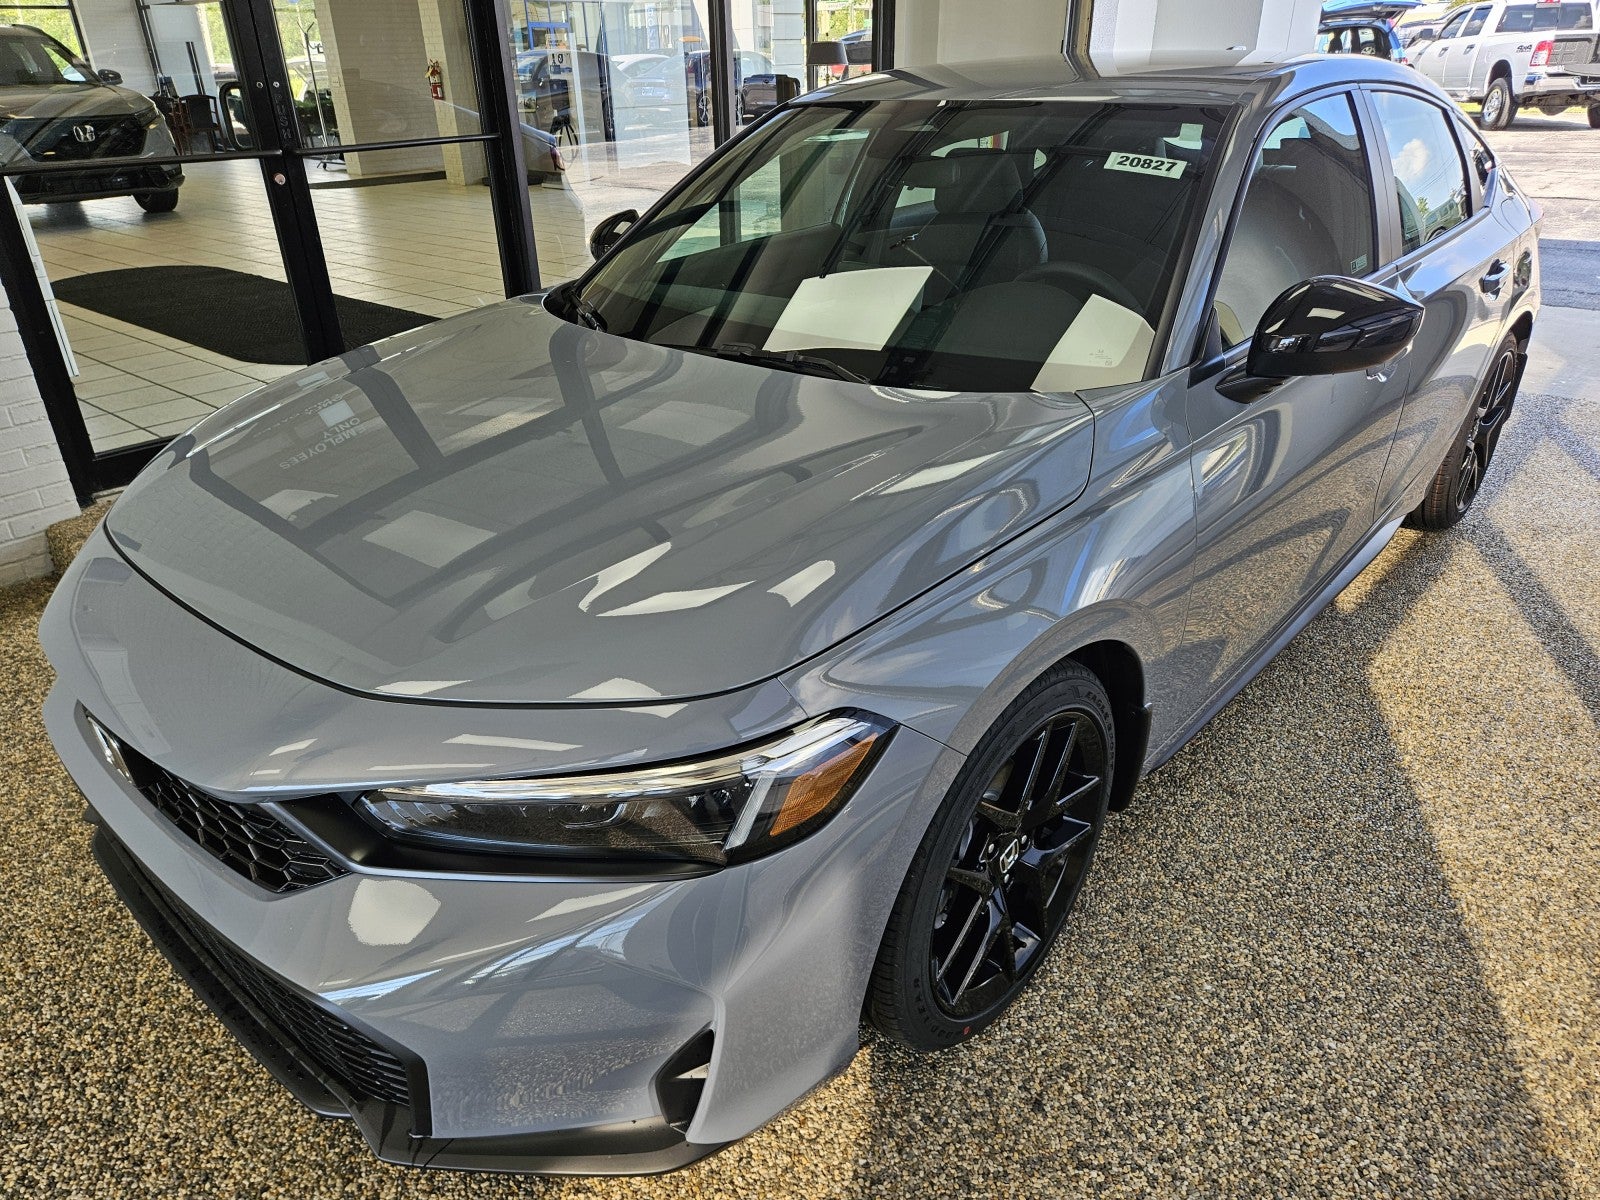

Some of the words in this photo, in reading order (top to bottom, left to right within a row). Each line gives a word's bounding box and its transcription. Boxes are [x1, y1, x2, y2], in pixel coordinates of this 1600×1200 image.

[1116, 155, 1178, 172] 20827
[323, 417, 361, 439] ONLY
[279, 426, 367, 470] EMPLOYEES
